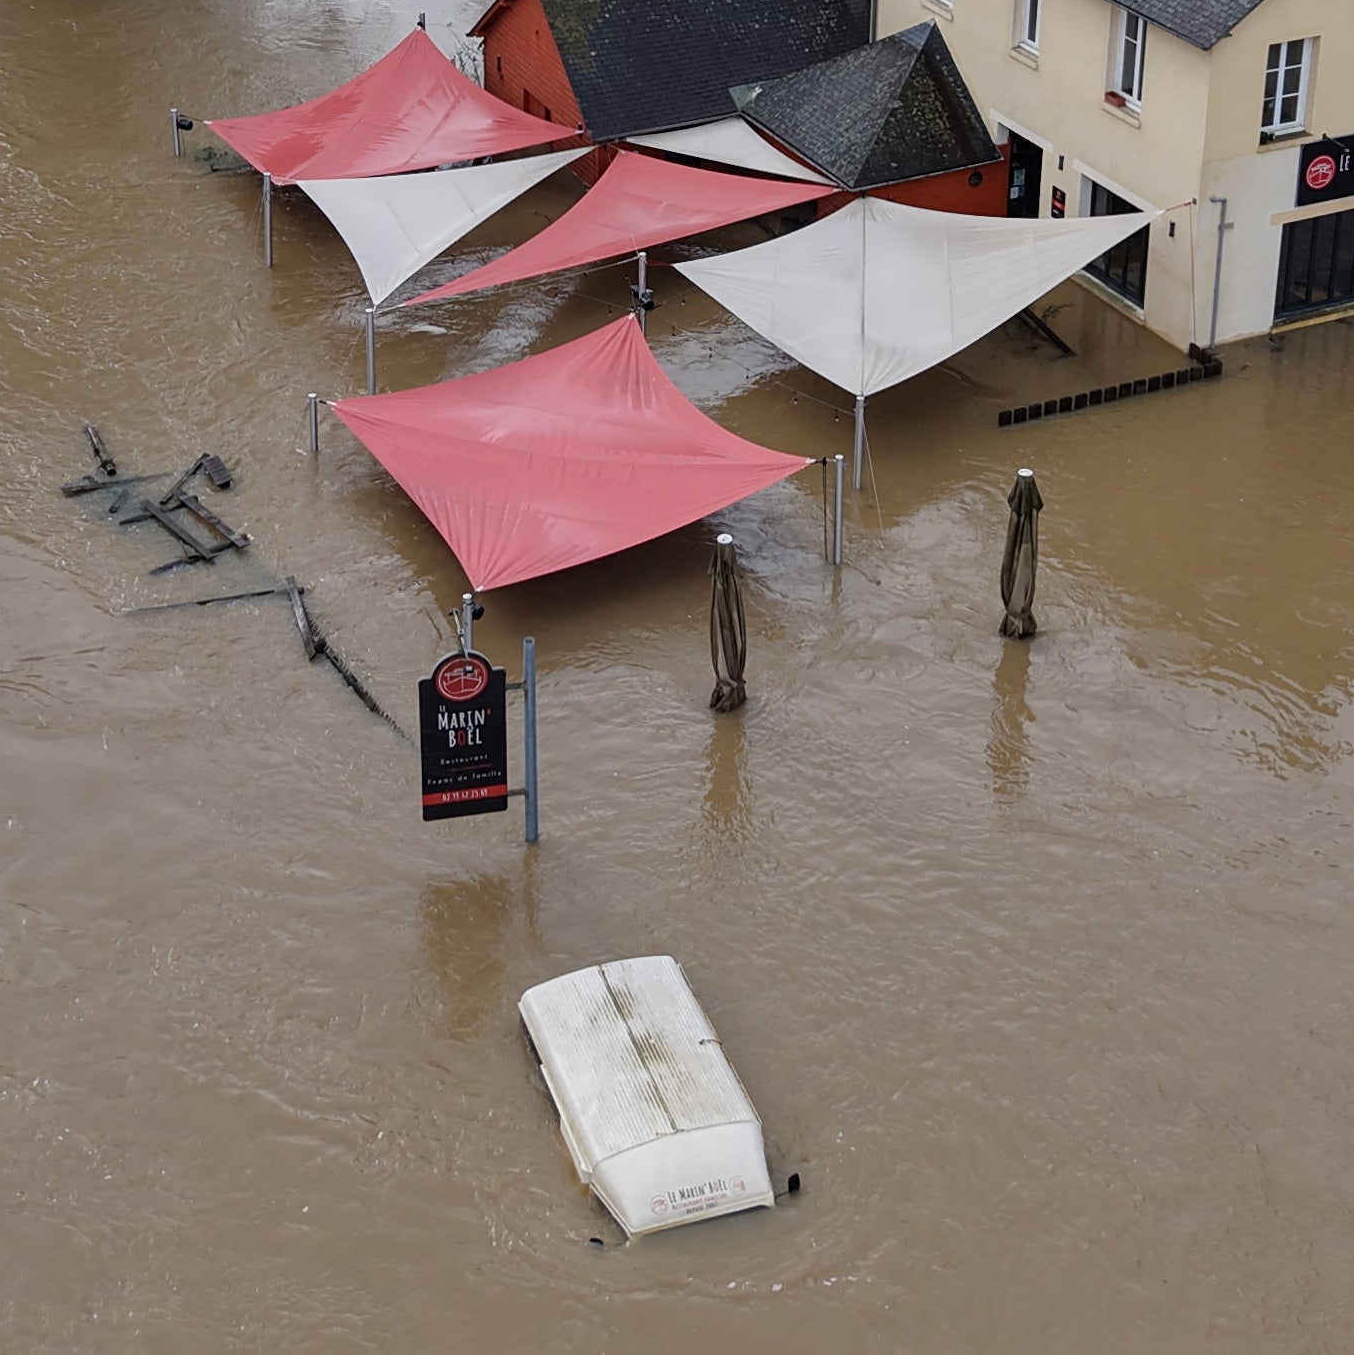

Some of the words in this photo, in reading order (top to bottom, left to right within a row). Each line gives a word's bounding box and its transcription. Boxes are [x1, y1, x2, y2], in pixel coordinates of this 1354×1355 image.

[1339, 154, 1350, 172] LE
[440, 754, 488, 765] Restaurant
[457, 774, 468, 782] de
[472, 770, 502, 779] famille
[667, 1191, 677, 1204] LE
